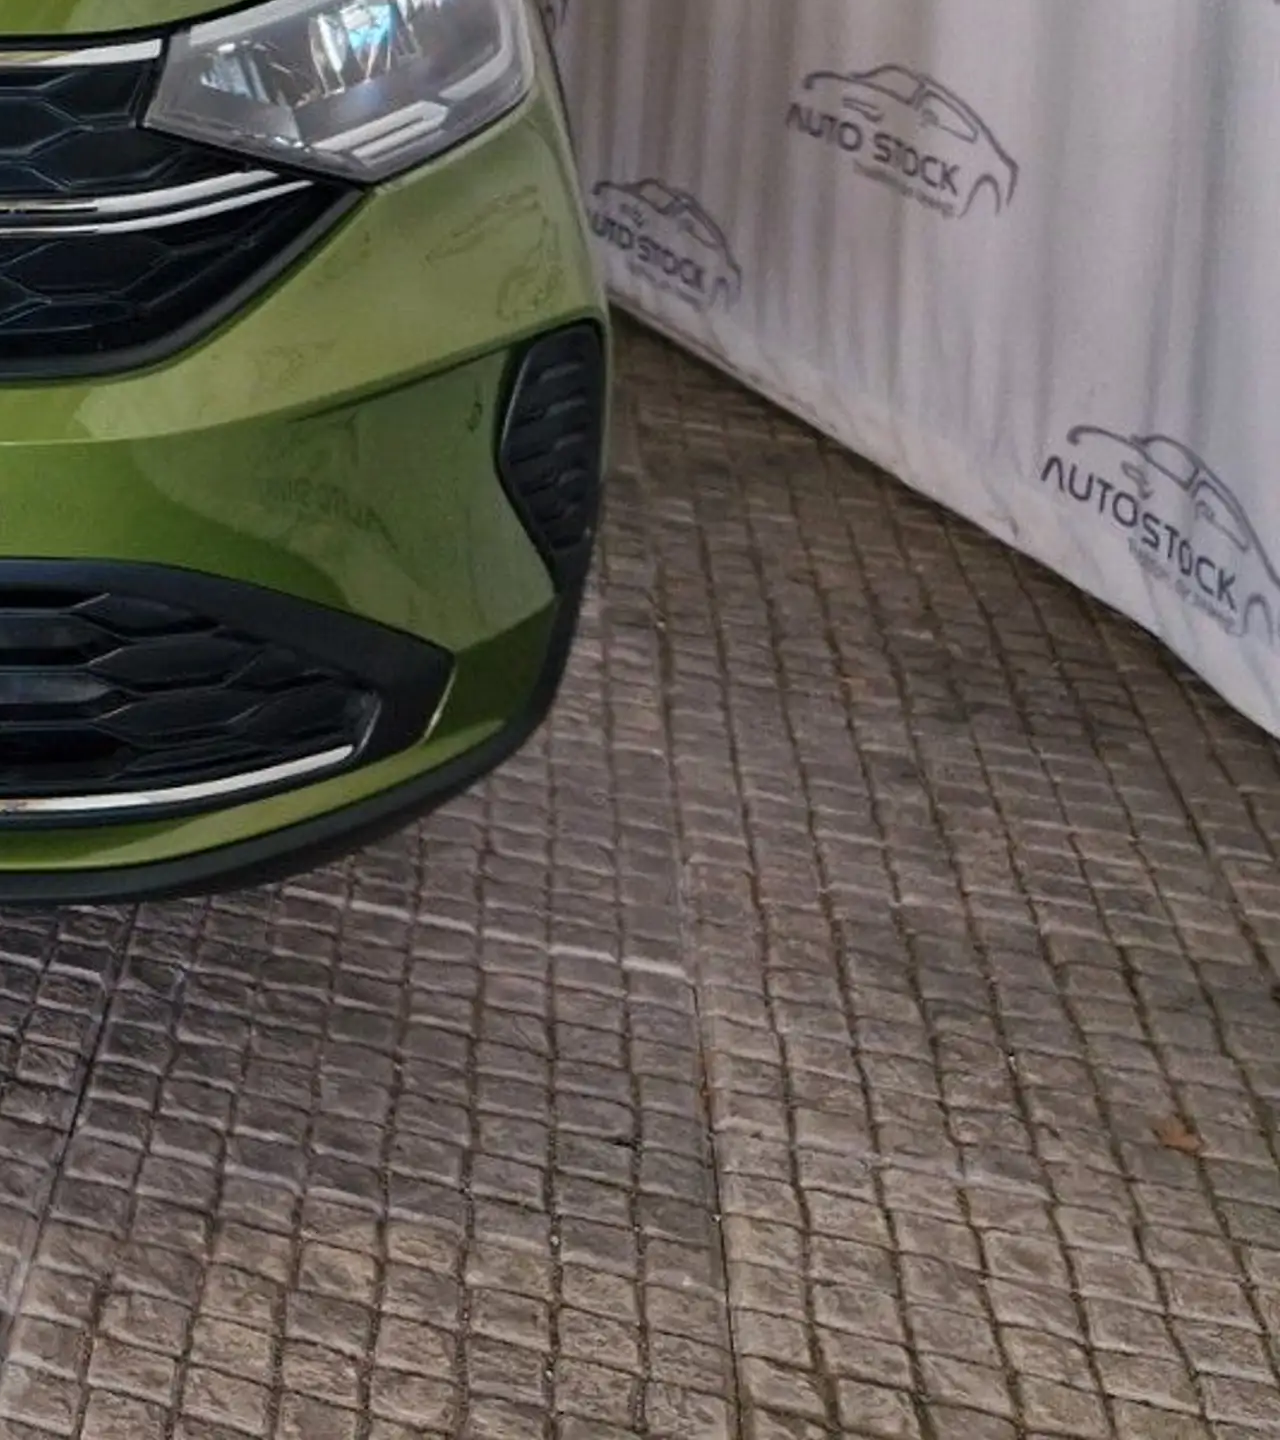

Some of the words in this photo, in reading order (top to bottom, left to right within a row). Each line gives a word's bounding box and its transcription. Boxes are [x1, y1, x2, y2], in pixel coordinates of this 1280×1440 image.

[785, 103, 863, 152] AUTO
[873, 132, 960, 197] STOCK
[1041, 456, 1138, 527] AUTO
[1142, 512, 1238, 612] STOCK
